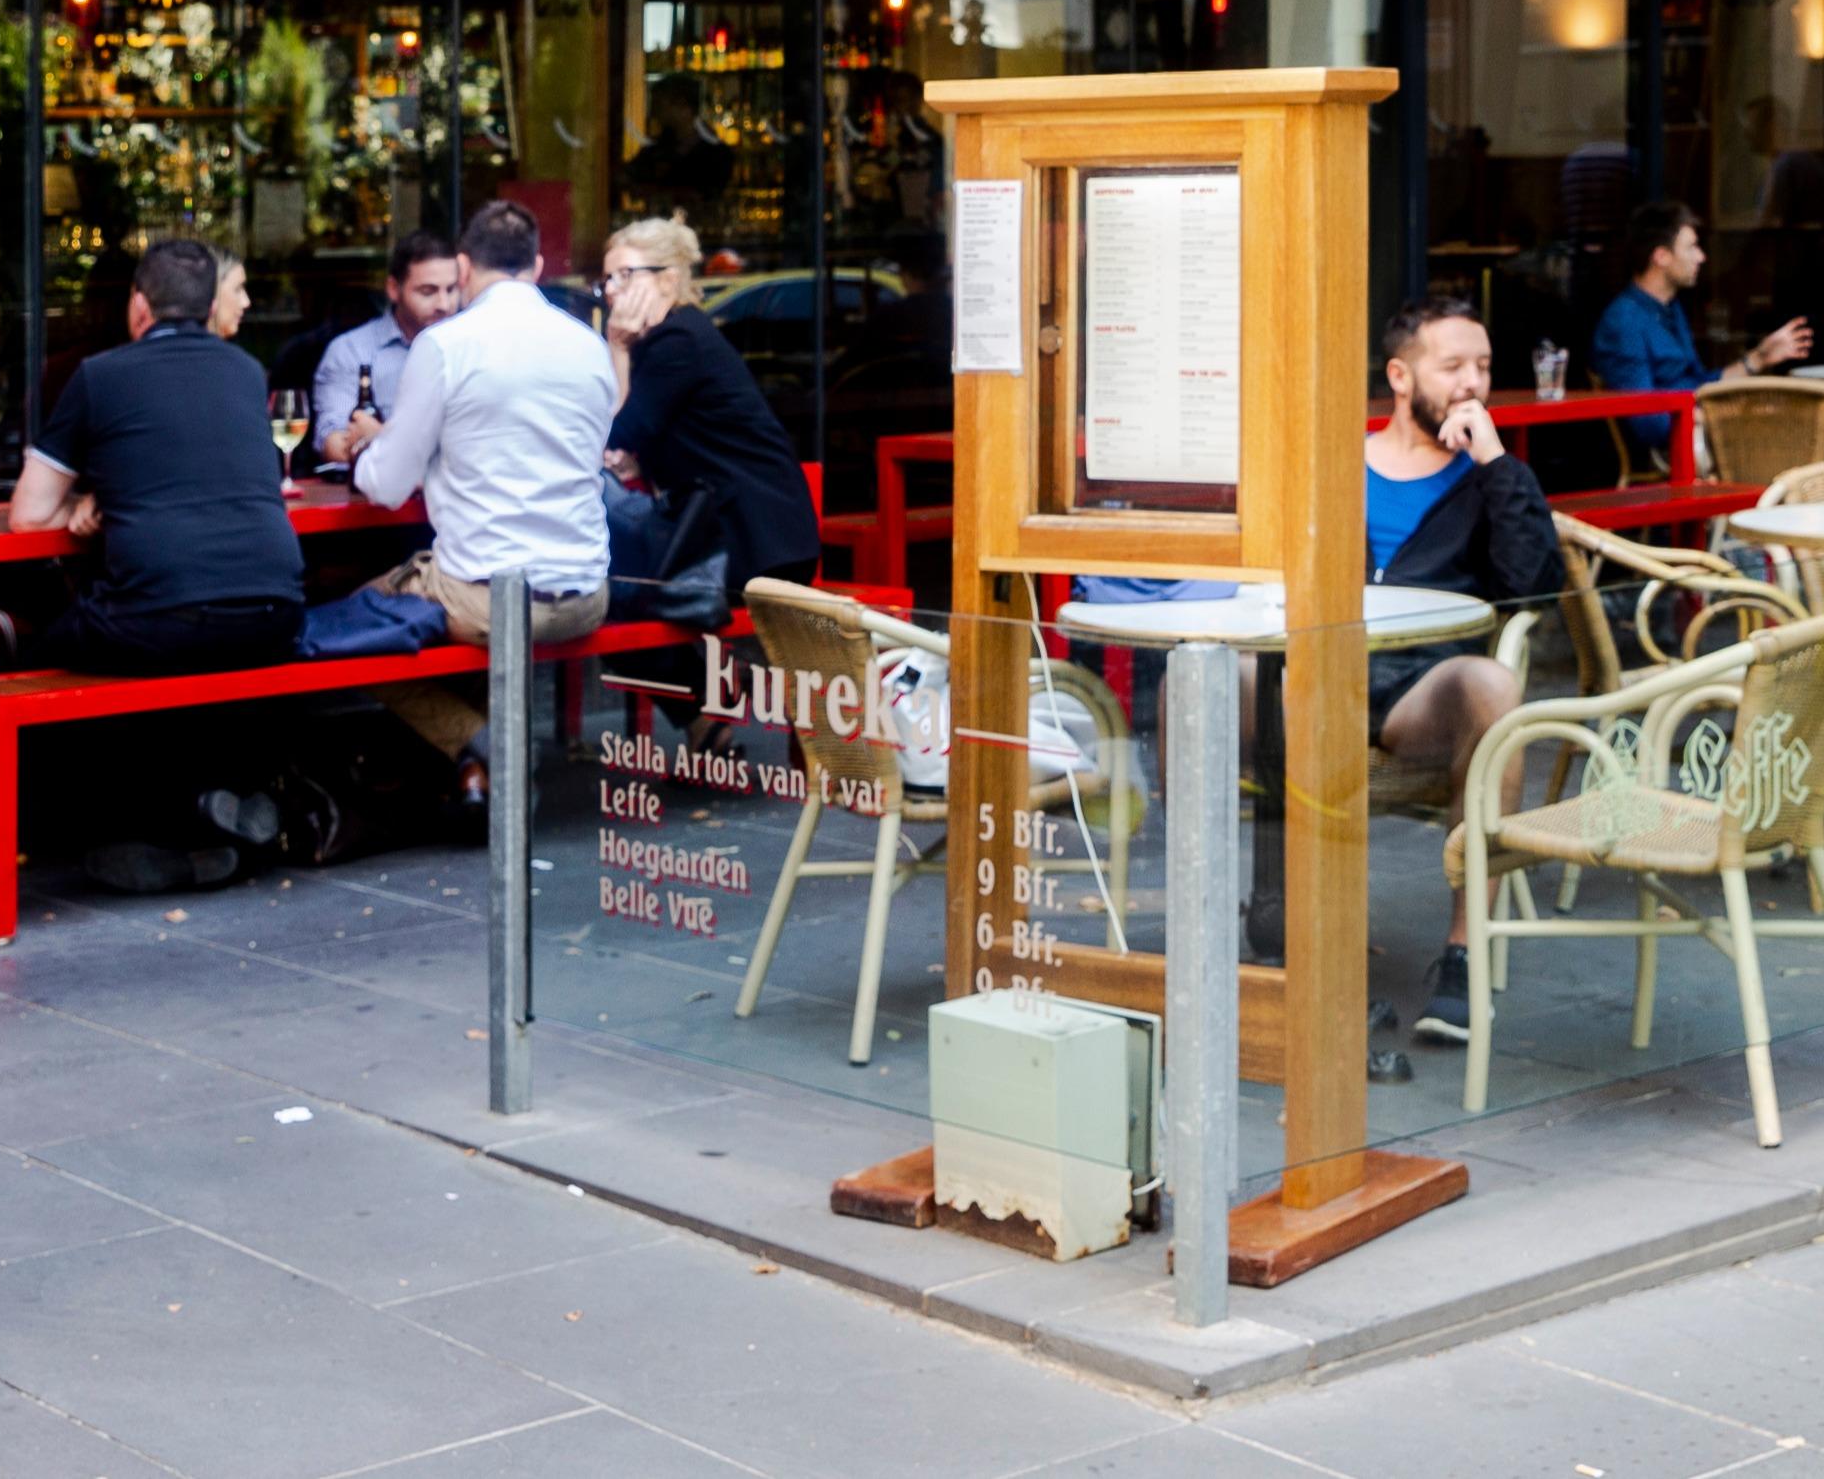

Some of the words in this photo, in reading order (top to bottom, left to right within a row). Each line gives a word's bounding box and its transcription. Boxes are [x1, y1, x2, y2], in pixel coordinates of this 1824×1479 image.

[700, 632, 942, 750] Eureka
[599, 730, 666, 773] Stella
[674, 743, 750, 789] Artois
[757, 763, 807, 800] van
[840, 776, 885, 813] vat
[599, 779, 662, 823] Leffe
[978, 802, 996, 842] 5
[1012, 809, 1065, 856] Bfr.
[598, 827, 748, 891] Hoegaarden
[978, 857, 996, 897] 9
[1012, 864, 1065, 912] Bfr.
[598, 876, 660, 922] Belle
[666, 890, 714, 934] Vue
[976, 911, 995, 952] 6
[1011, 919, 1064, 968] Bfr.
[975, 966, 994, 1004] 9
